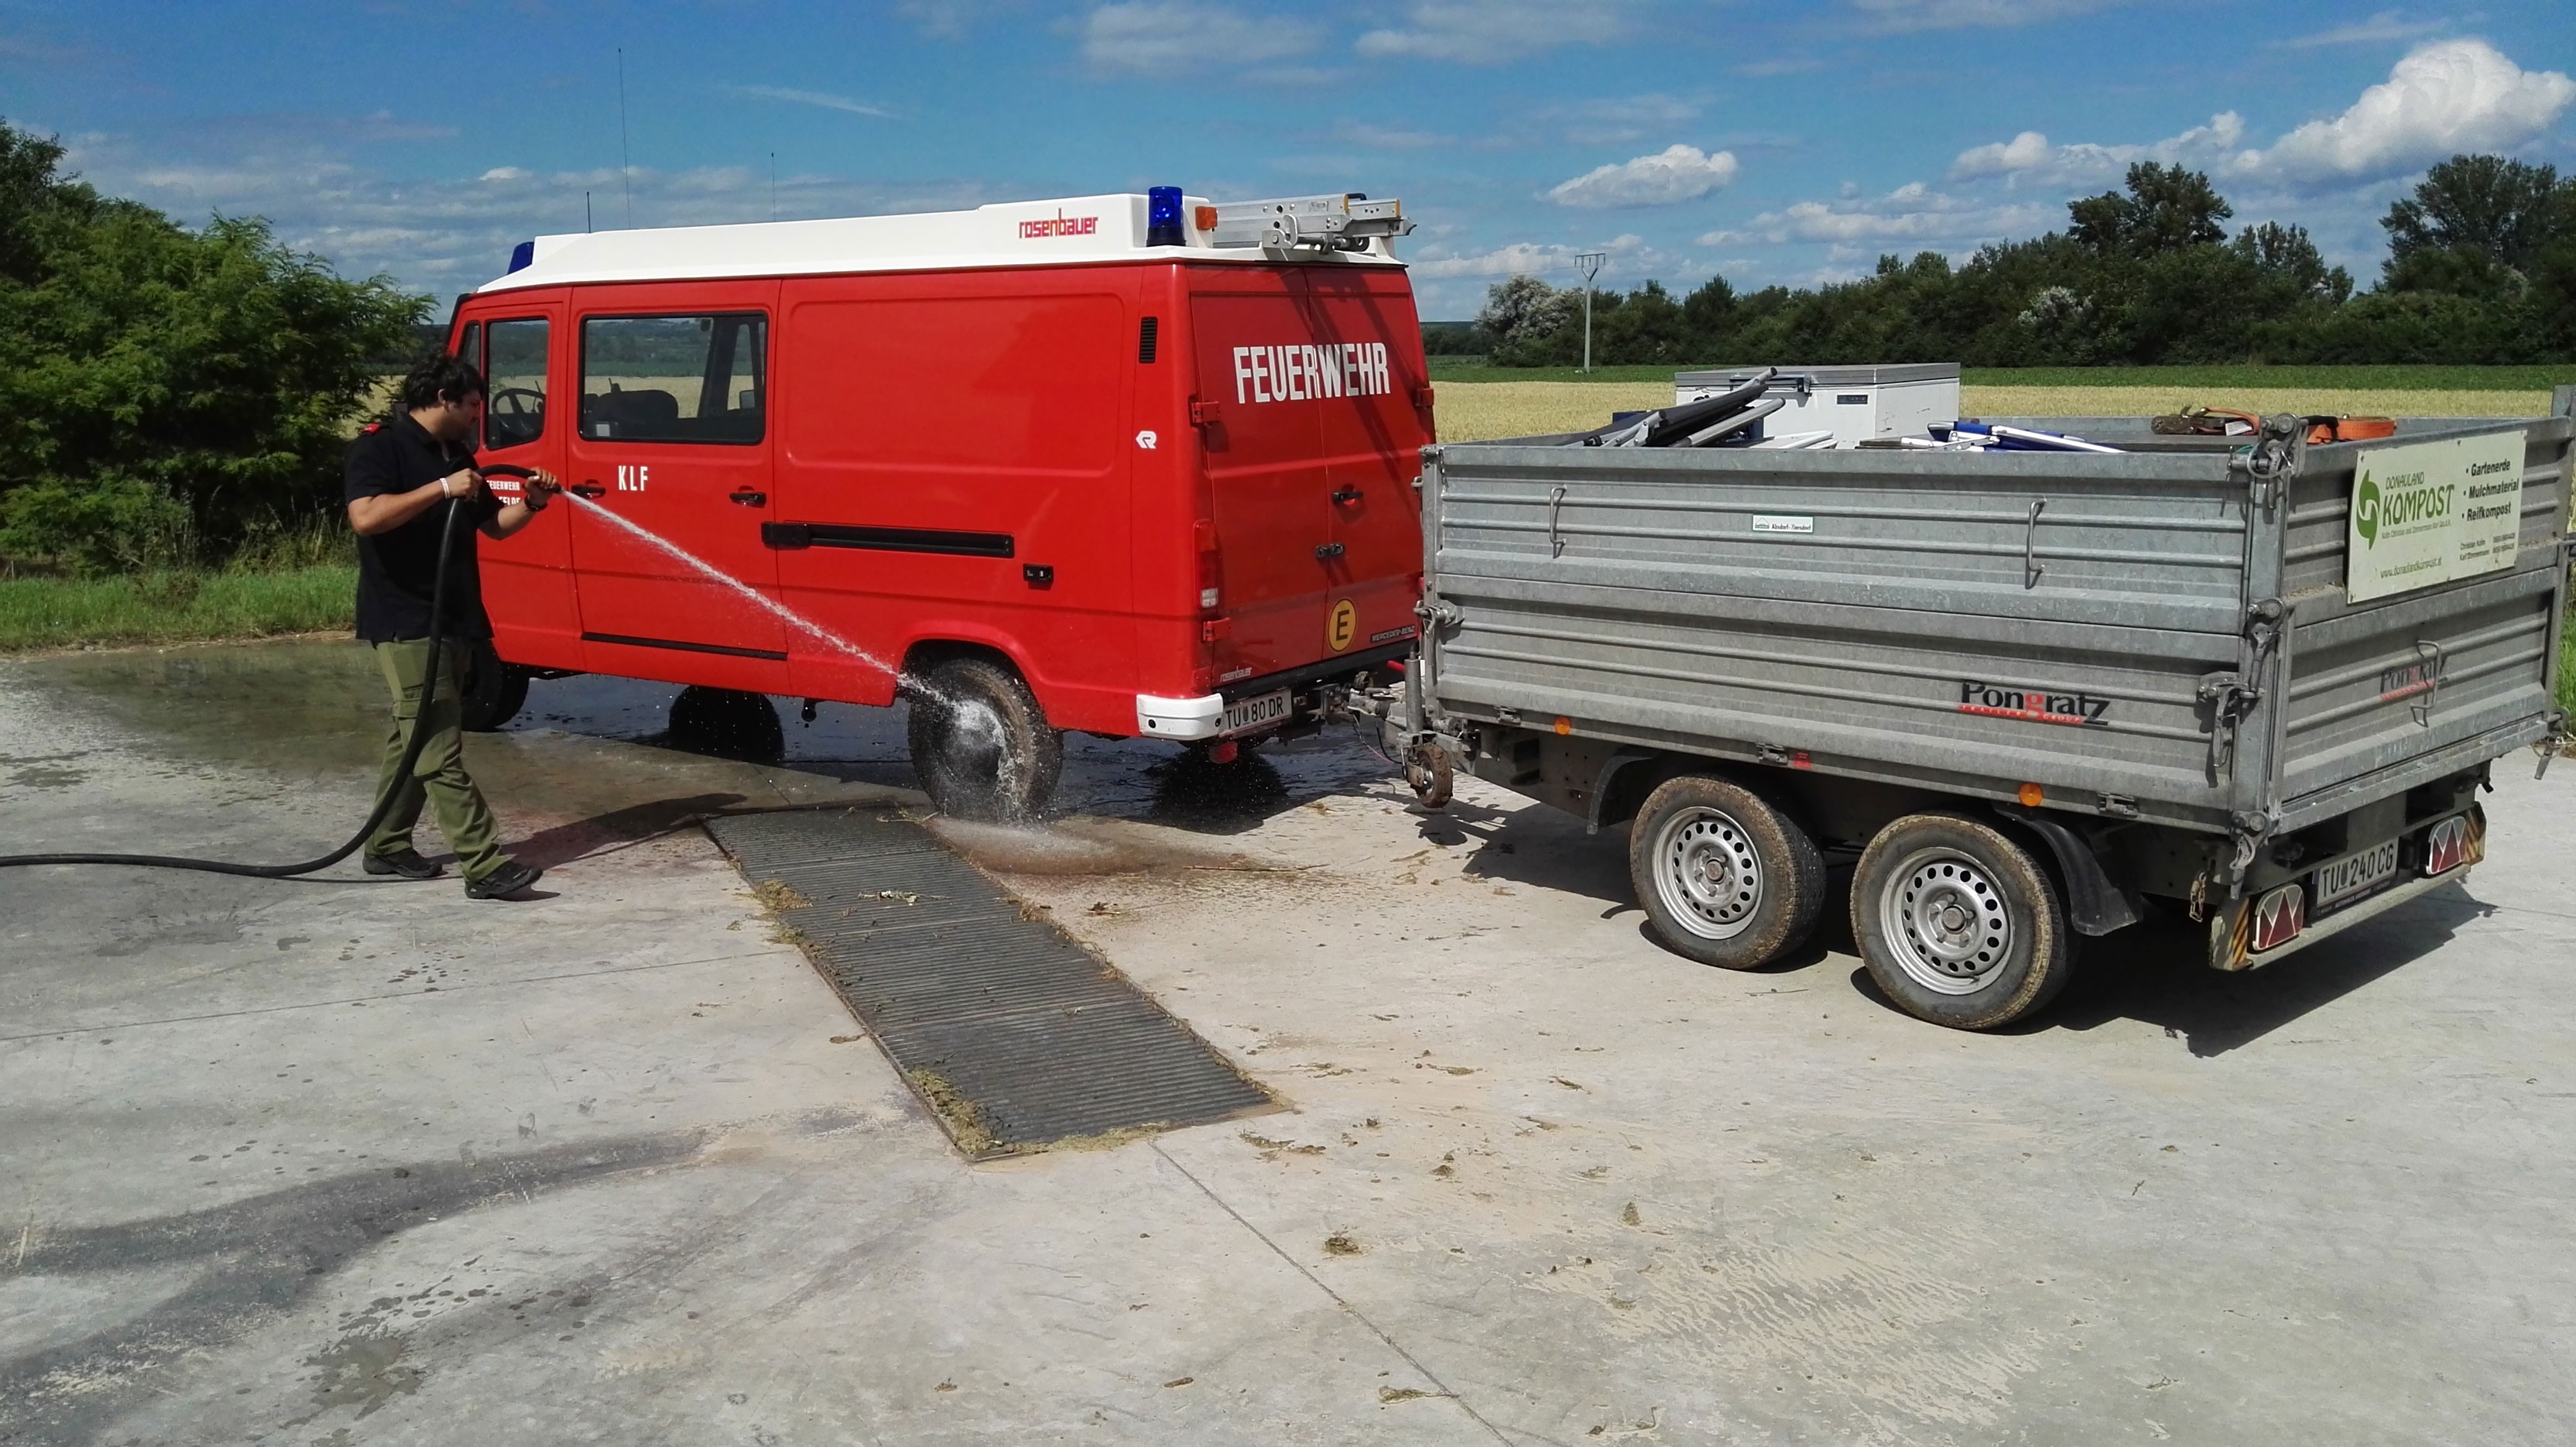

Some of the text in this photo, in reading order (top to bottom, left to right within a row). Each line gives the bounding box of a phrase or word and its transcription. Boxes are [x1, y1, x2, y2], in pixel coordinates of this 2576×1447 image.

[1019, 207, 1098, 238] rosenbauer
[1233, 342, 1391, 404] FEUERWEHR
[618, 465, 649, 492] KLF
[2386, 471, 2425, 490] DONAULAND
[2471, 458, 2511, 476] Gartenerde
[2468, 478, 2519, 499] Mulchmaterial
[2382, 484, 2454, 526] KOMPOST
[2467, 502, 2511, 523] Reifkompost
[1336, 609, 1350, 641] E
[1225, 697, 1283, 729] TU 80 DR
[1961, 679, 2110, 725] Pongratz
[2043, 714, 2081, 722] GROUP
[2323, 843, 2393, 897] TU 240 CG
